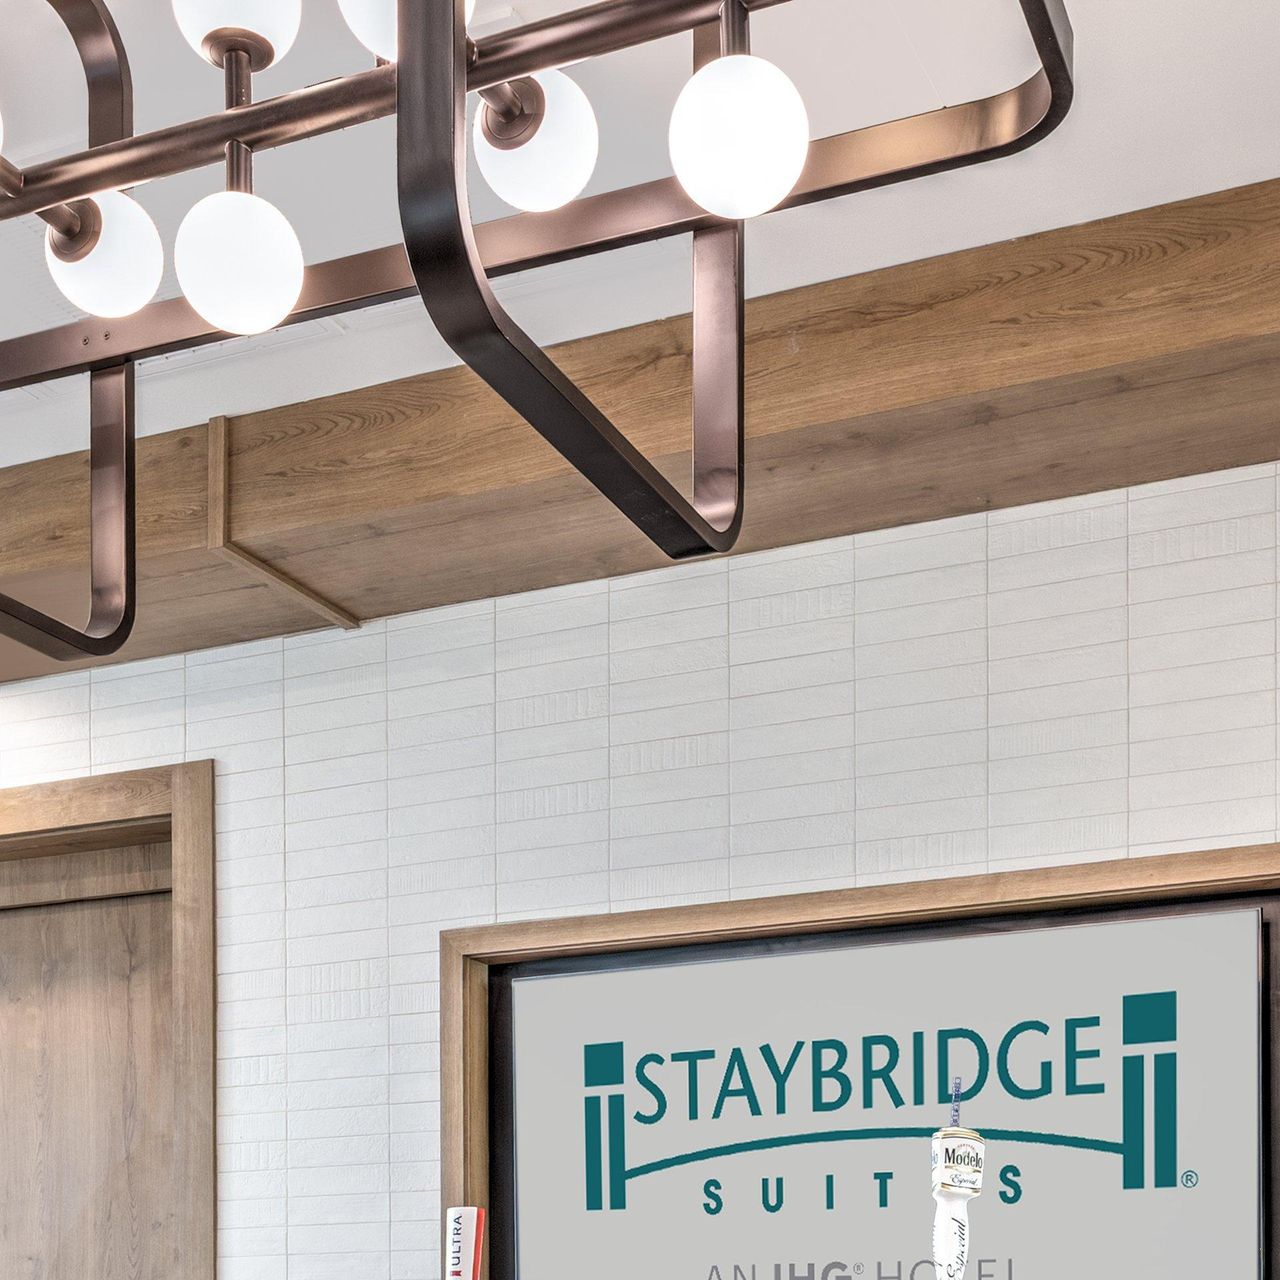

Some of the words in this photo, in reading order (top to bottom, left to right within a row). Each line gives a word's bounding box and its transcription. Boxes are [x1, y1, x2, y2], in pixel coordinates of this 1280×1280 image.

[633, 1016, 1105, 1125] STAYBRIDGE
[944, 1147, 983, 1169] Modelo
[703, 1165, 1022, 1215] SUITS
[451, 1215, 463, 1266] ULTRA
